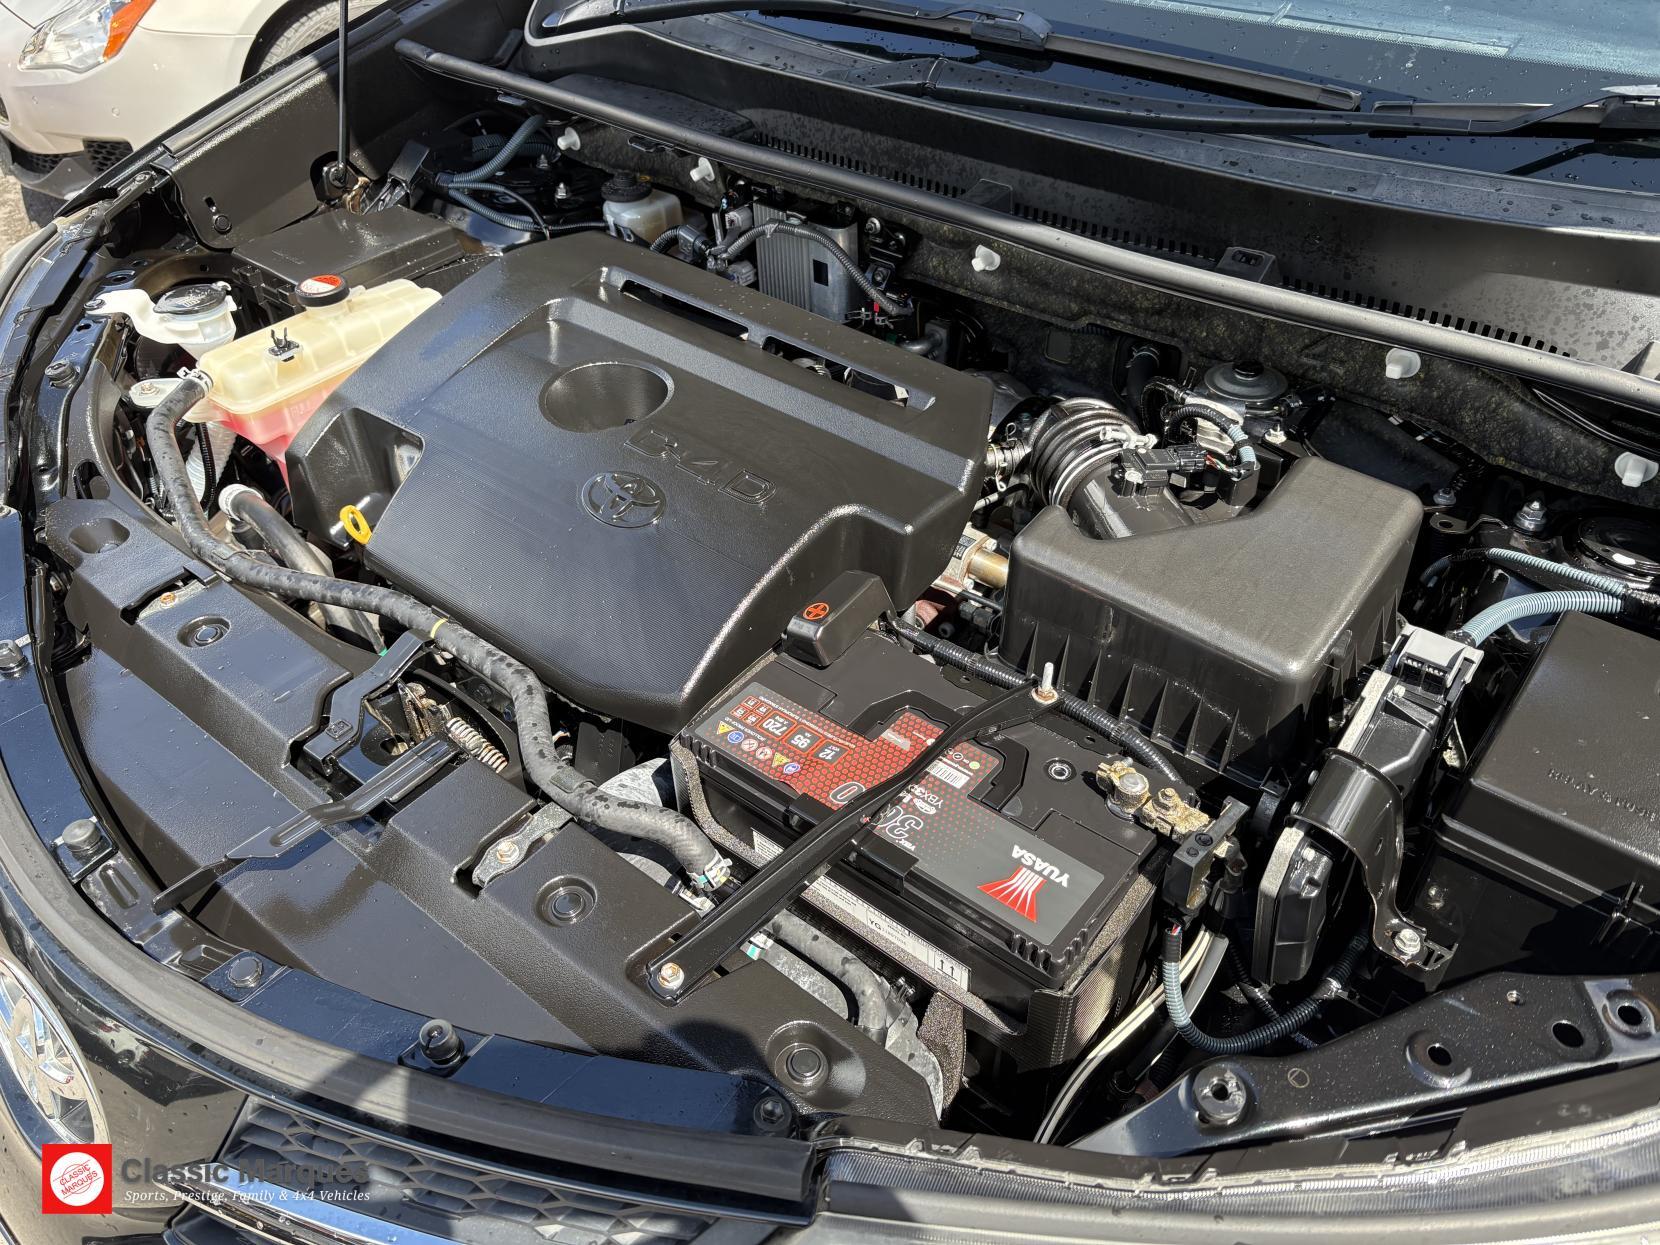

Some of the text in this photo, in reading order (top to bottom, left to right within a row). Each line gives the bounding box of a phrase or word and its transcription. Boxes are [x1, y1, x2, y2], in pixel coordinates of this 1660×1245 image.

[762, 718, 788, 736] 720
[790, 734, 811, 748] 95
[818, 748, 836, 760] 12
[829, 781, 924, 839] 300
[1011, 844, 1070, 888] YUASA
